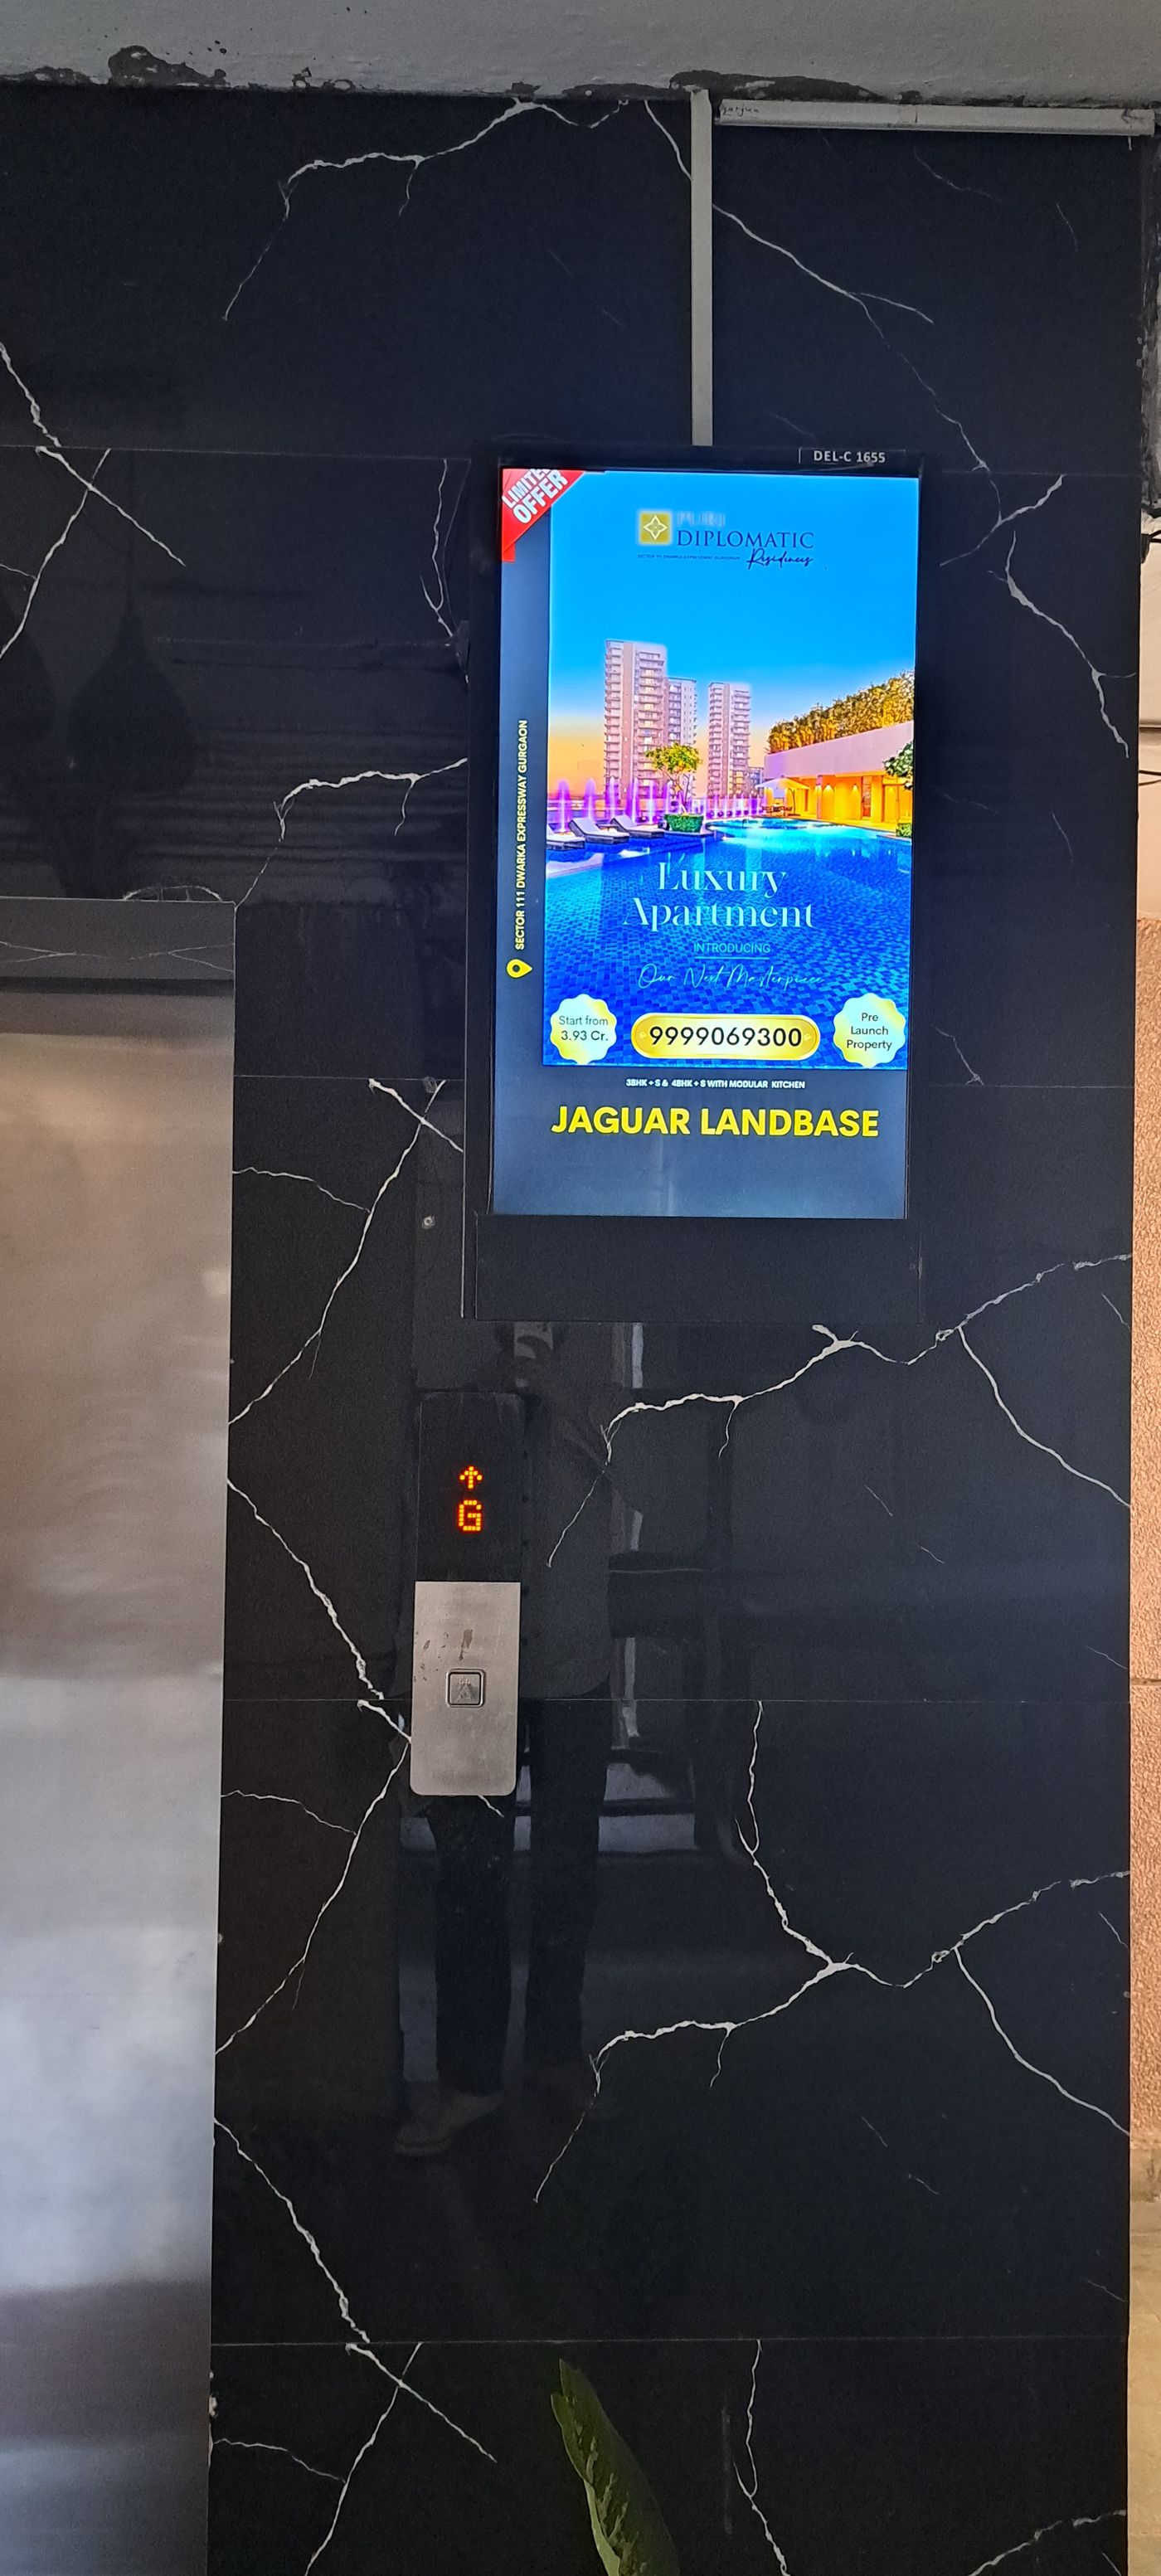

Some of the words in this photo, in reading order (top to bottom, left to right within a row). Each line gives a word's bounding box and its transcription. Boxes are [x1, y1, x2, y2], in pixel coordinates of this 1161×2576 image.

[814, 450, 852, 462] DEL-C
[856, 451, 886, 464] 1655
[502, 469, 551, 508] LIMITE
[513, 469, 569, 523] OFFER
[677, 530, 814, 549] DIPLOMATIC
[746, 548, 814, 570] Residences
[517, 720, 528, 773] GURGAON
[516, 775, 527, 842] EXPRESSWAY
[516, 843, 527, 888] DWARKA
[658, 862, 787, 899] Luxury
[516, 891, 526, 907] 111
[624, 897, 814, 932] Apartment
[515, 910, 526, 950] SECTOR
[693, 942, 771, 953] INTRODUCING
[638, 963, 677, 989] Our
[683, 963, 730, 988] Next
[726, 964, 826, 991] Masterpiece
[559, 1015, 582, 1026] Start
[585, 1015, 609, 1026] from
[861, 1013, 879, 1022] Pre
[561, 1030, 587, 1041] 3.93
[590, 1031, 609, 1041] Cr.
[649, 1026, 802, 1047] 9999069300
[851, 1026, 888, 1035] Launch
[847, 1039, 892, 1052] Property
[729, 1080, 768, 1088] MODULAR
[771, 1081, 805, 1089] KITCHEN
[551, 1106, 690, 1135] JAGUAR
[701, 1108, 879, 1137] LANDBASE
[459, 1499, 482, 1531] G
